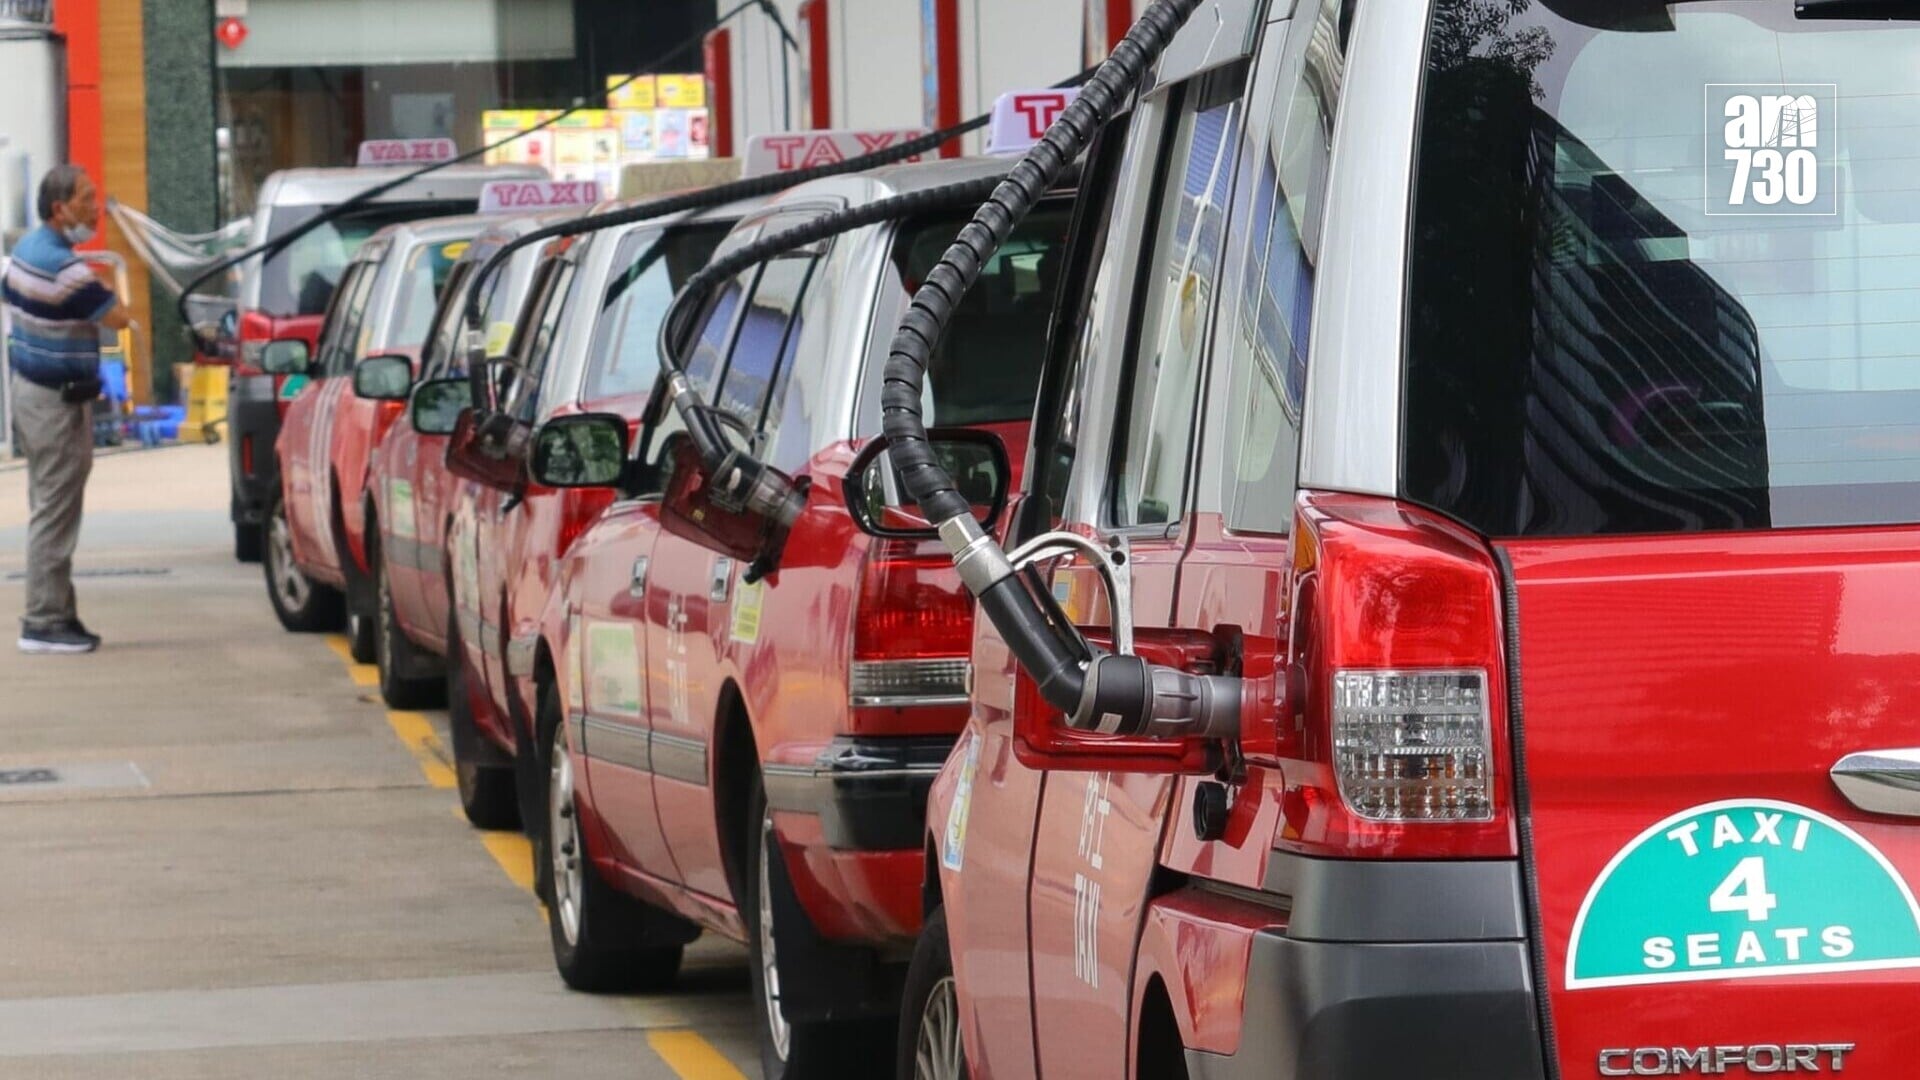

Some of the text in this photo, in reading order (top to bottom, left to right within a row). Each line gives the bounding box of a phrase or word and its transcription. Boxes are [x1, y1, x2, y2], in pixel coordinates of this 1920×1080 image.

[366, 140, 450, 161] TAXI
[491, 181, 597, 206] TAXI
[1666, 811, 1812, 857] TAXI
[1709, 855, 1777, 922] 4
[1642, 925, 1855, 969] SEATS
[1598, 1042, 1856, 1077] COMFORT
